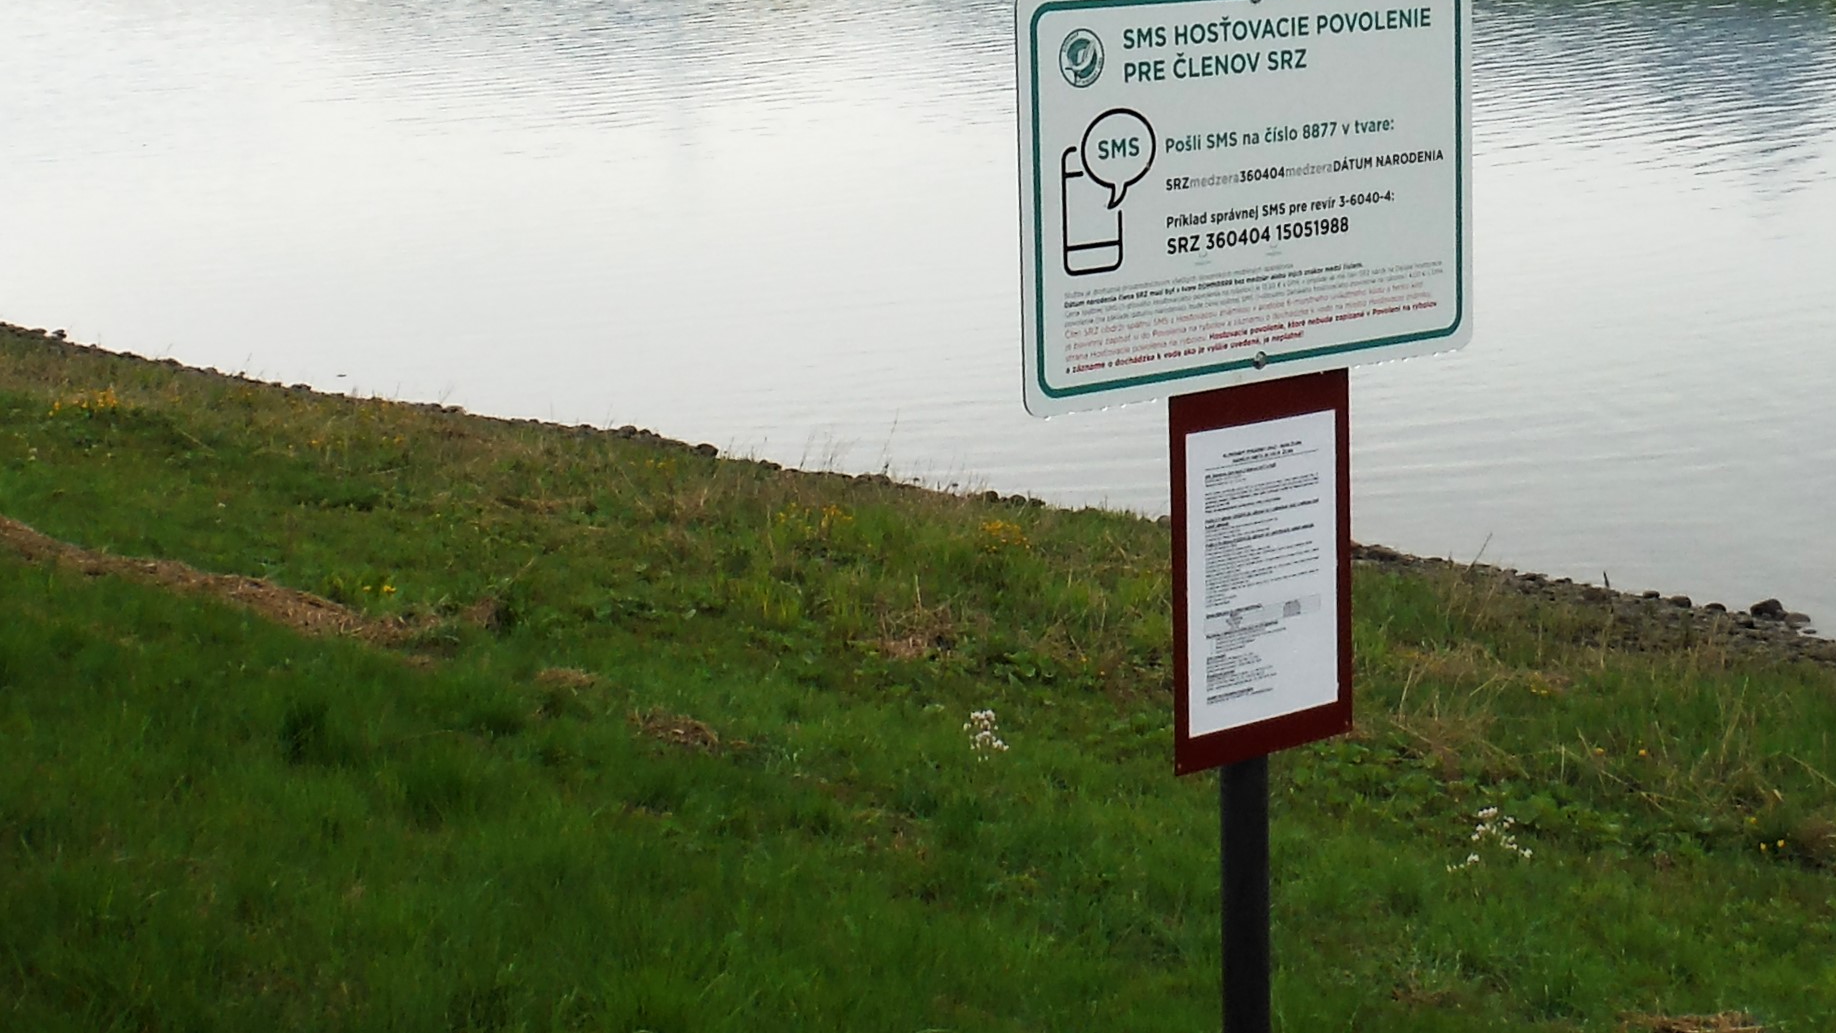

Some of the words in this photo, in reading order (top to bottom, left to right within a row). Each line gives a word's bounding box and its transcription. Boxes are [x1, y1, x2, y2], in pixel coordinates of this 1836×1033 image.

[1124, 27, 1166, 49] SMS
[1175, 16, 1309, 45] HOSŤOVACIE
[1317, 8, 1431, 34] POVOLENIE
[1124, 60, 1165, 83] PRE
[1173, 52, 1260, 78] ČLENOV
[1268, 49, 1307, 70] SRZ
[1098, 137, 1139, 159] SMS
[1166, 135, 1201, 153] Pošli
[1207, 132, 1237, 149] SMS
[1243, 133, 1259, 145] na
[1265, 126, 1297, 143] číslo
[1303, 122, 1337, 139] 8877
[1342, 124, 1349, 134] v
[1355, 120, 1393, 133] tvare:
[1376, 150, 1443, 167] NARODENIA
[1167, 212, 1207, 228] Príklad
[1211, 206, 1258, 224] správnej
[1263, 203, 1285, 216] SMS
[1289, 203, 1307, 215] pre
[1311, 197, 1335, 211] revír
[1339, 191, 1394, 207] 3-6040-4:
[1168, 235, 1200, 254] SRZ
[1206, 226, 1270, 249] 360404
[1276, 217, 1348, 240] 15051988
